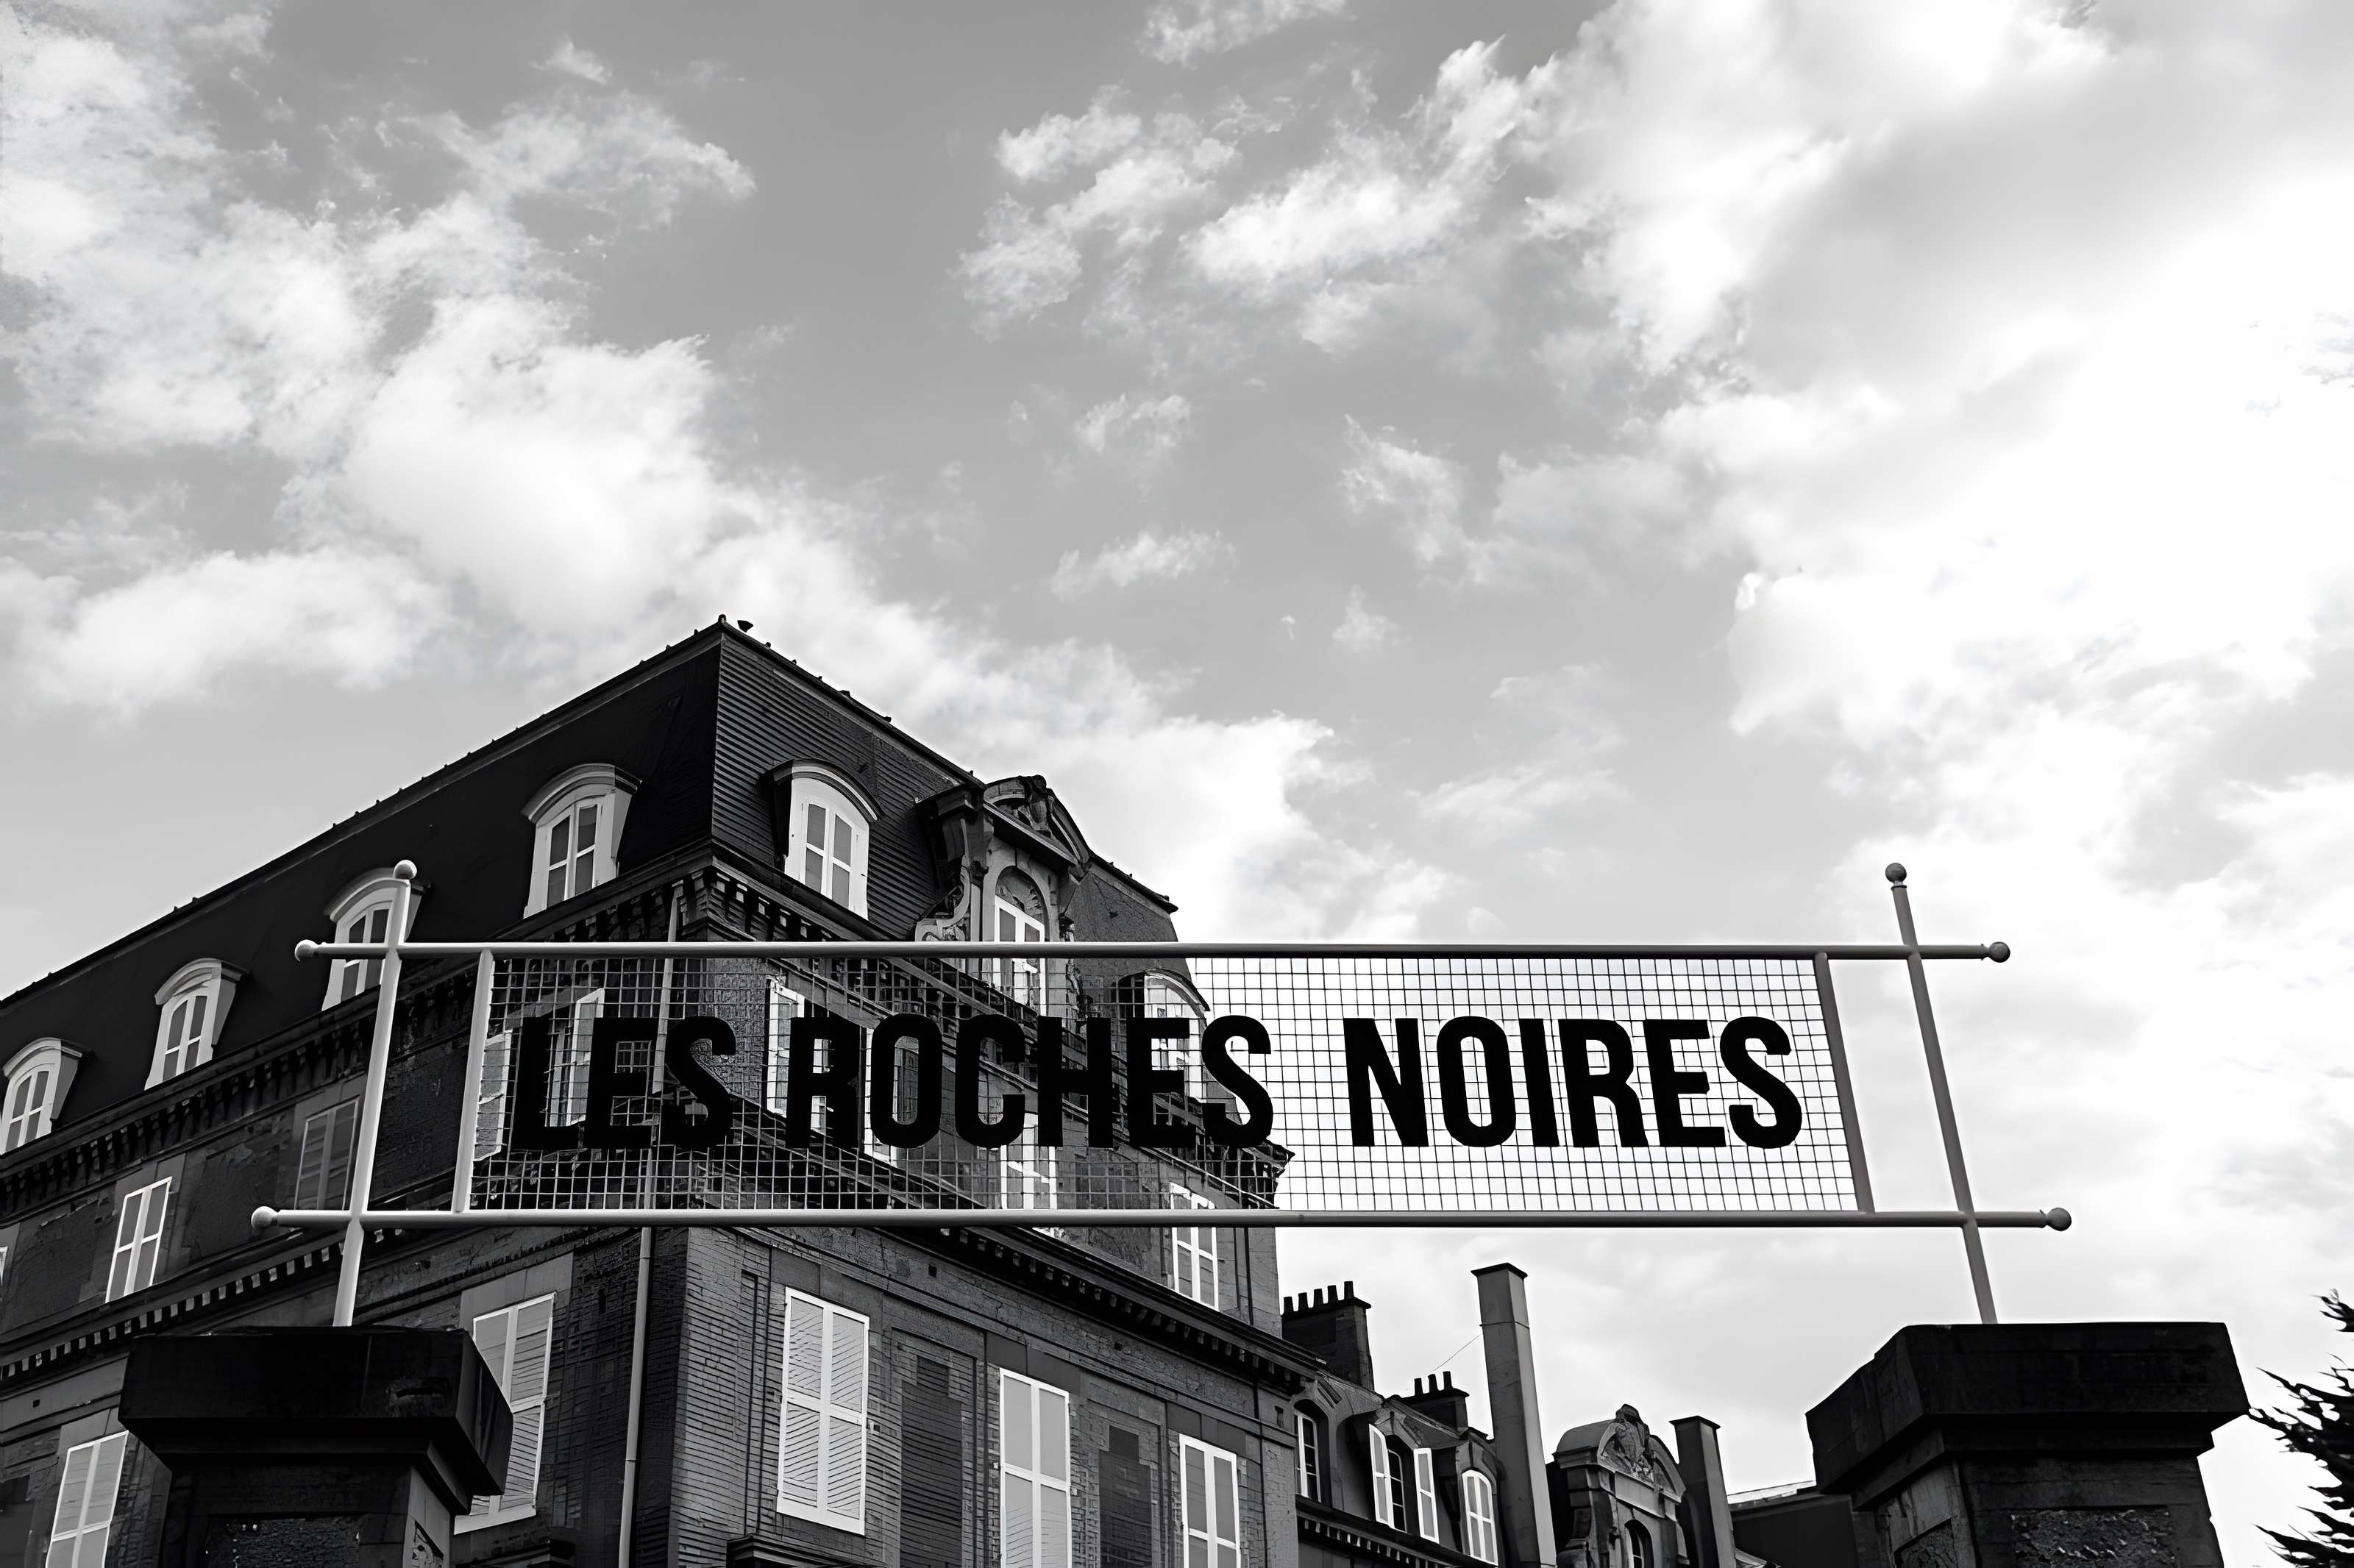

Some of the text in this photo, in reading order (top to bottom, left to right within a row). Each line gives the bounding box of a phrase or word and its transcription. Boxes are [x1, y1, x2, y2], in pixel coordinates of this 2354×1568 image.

[513, 1013, 1803, 1150] LES ROCHES NOIRES
